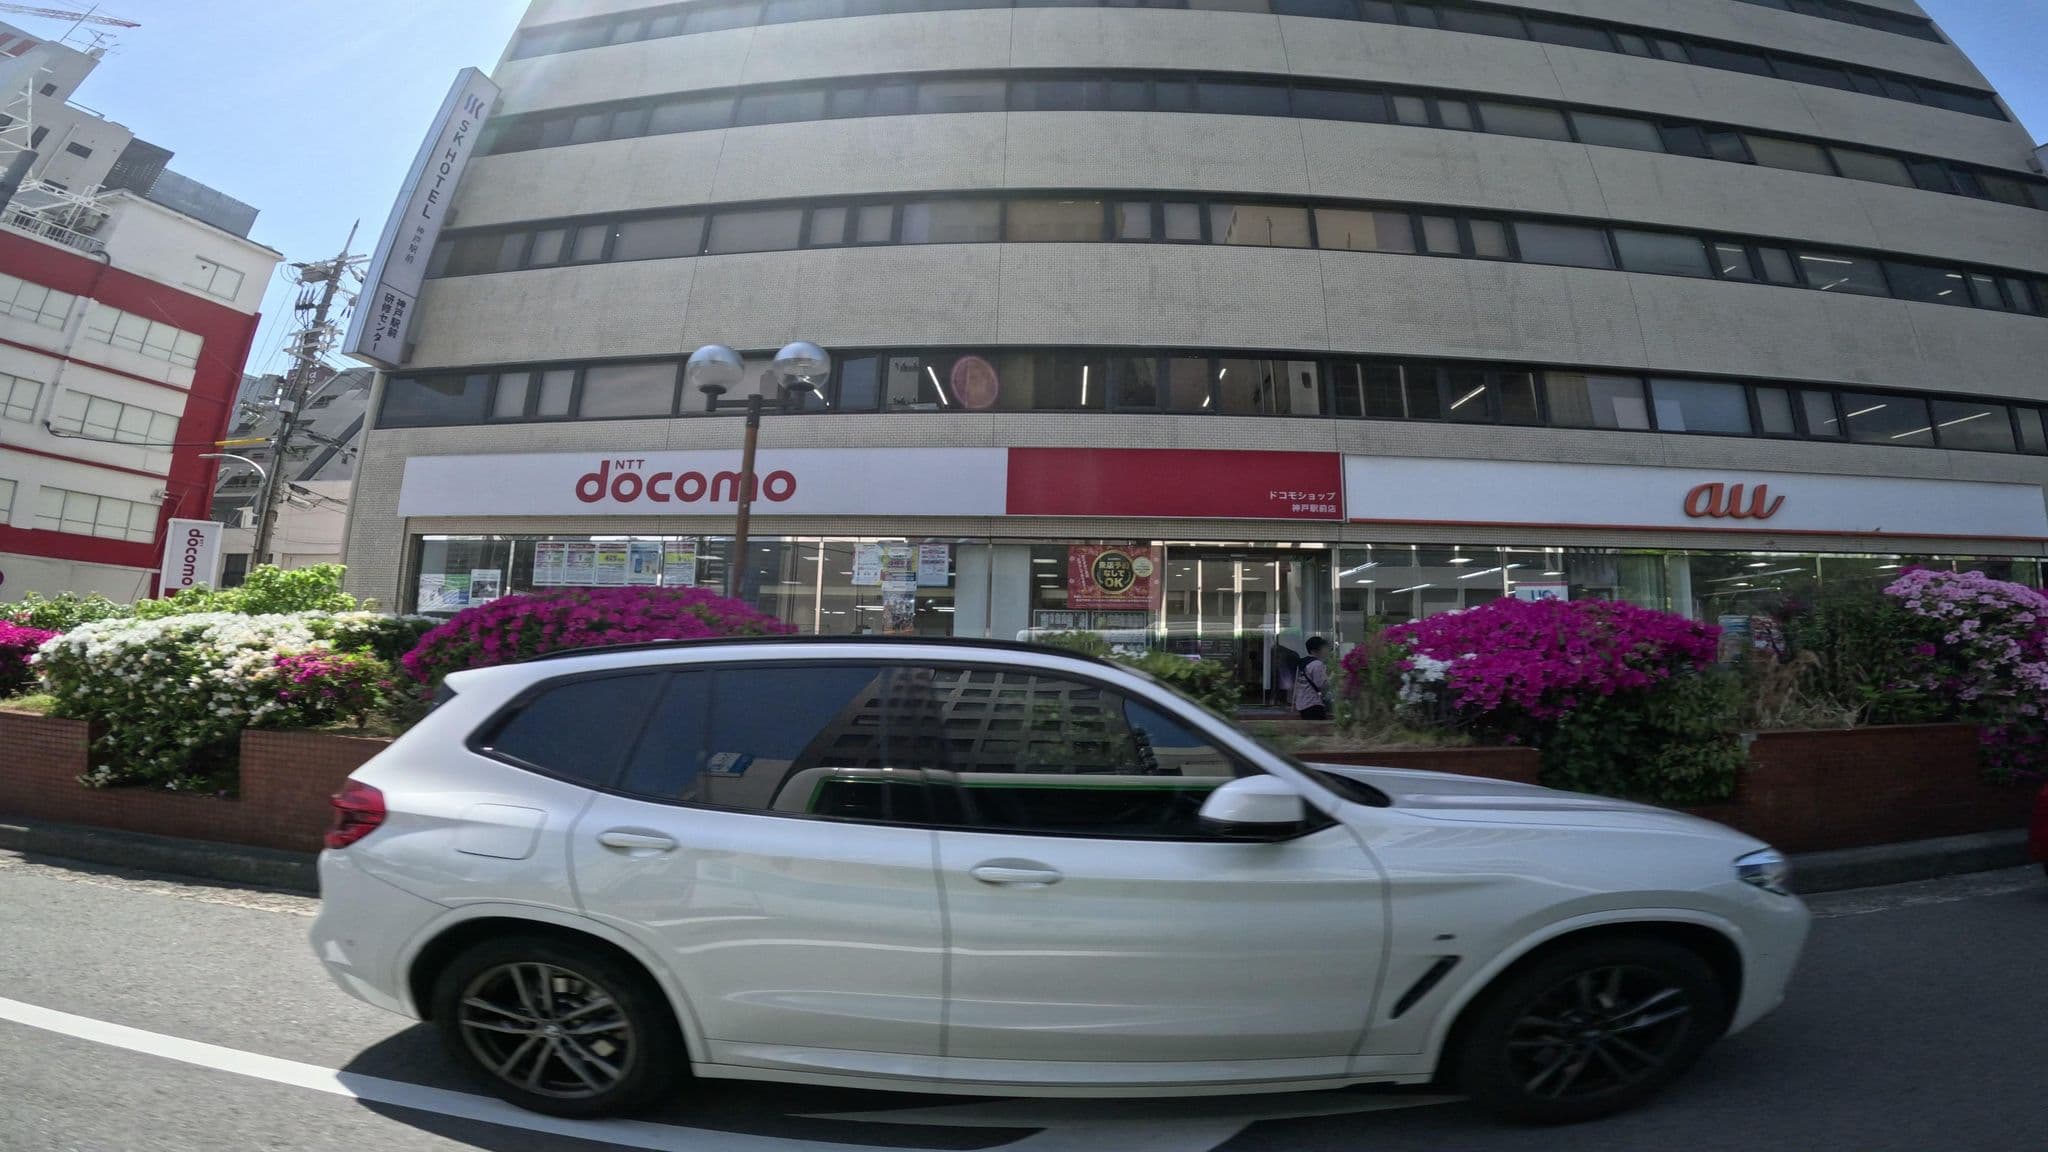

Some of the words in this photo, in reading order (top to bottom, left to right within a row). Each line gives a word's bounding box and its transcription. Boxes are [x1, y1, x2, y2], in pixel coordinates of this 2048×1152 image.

[453, 119, 470, 147] SK
[422, 147, 457, 219] HOTEL
[372, 292, 395, 352] 研修センター
[387, 298, 407, 339] 神戸駅前
[576, 460, 797, 503] docomo
[615, 459, 645, 470] NTT
[1269, 490, 1336, 501] ドコモショップ
[1292, 503, 1337, 513] 神戸駅前店
[1684, 482, 1786, 520] au
[181, 528, 204, 586] docomo
[1104, 577, 1123, 588] OK
